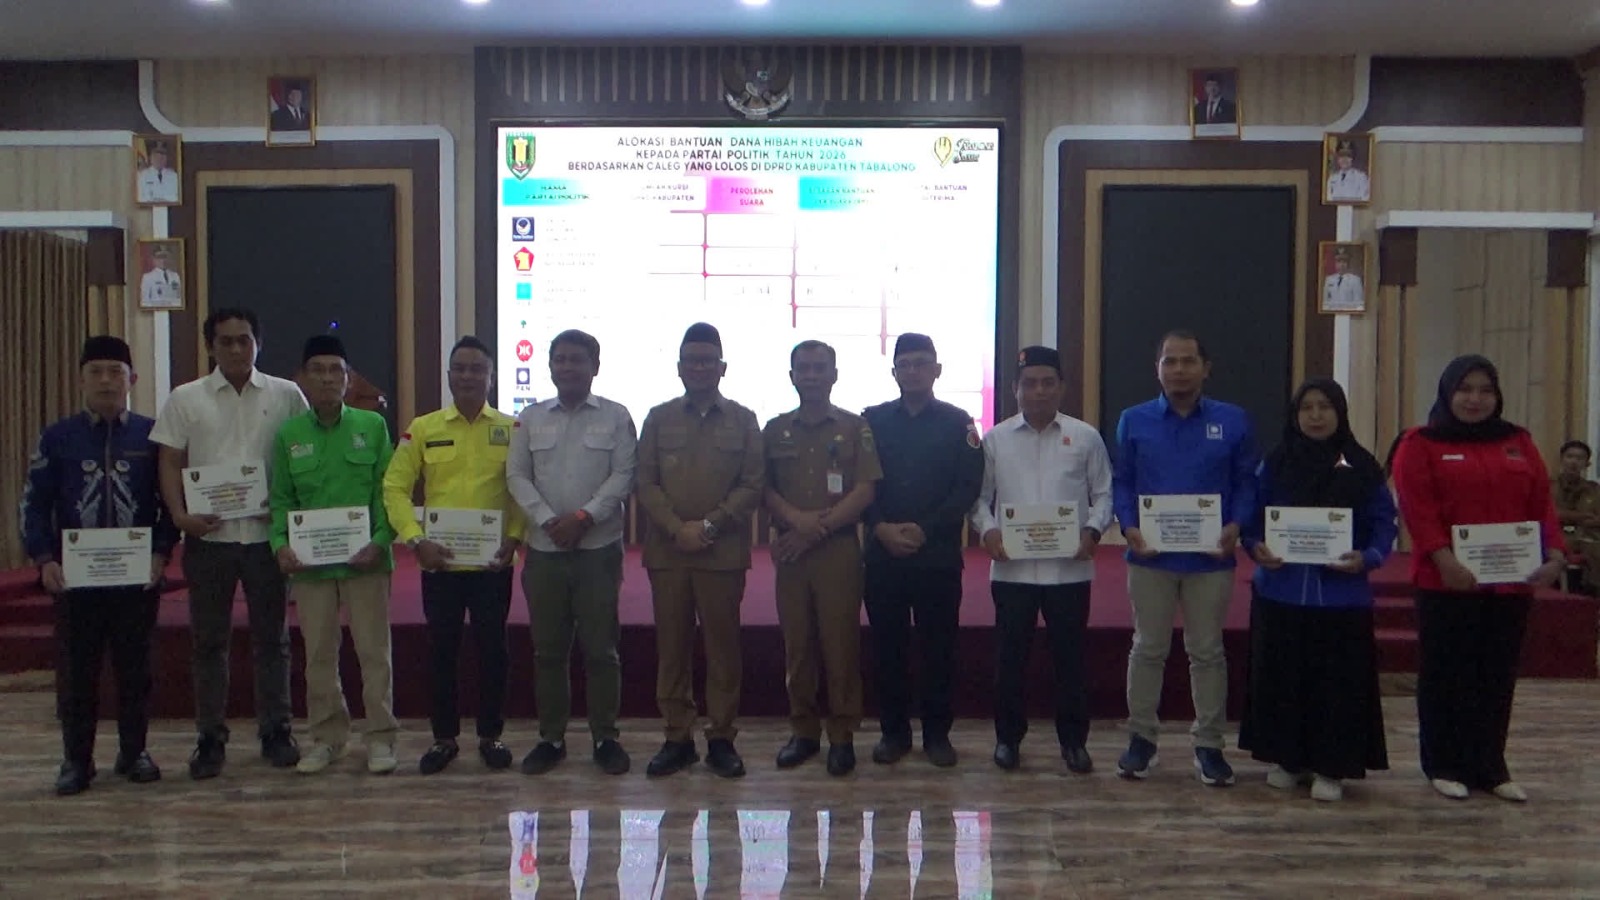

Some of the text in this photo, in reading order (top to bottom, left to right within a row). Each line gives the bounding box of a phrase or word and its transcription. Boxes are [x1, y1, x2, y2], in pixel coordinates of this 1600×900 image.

[617, 136, 863, 147] ALOKASI BANTUAN DANA HIBAH KEUANGAN
[636, 149, 846, 160] KEPADA PARTAI POLITIK TAHUN 2026
[568, 161, 916, 172] BERDASARKAN CALEG YANG LOLOS DI DPRD KABUPATEN TABALONG
[730, 187, 774, 195] PEROLEHAN
[739, 198, 765, 206] SUARA
